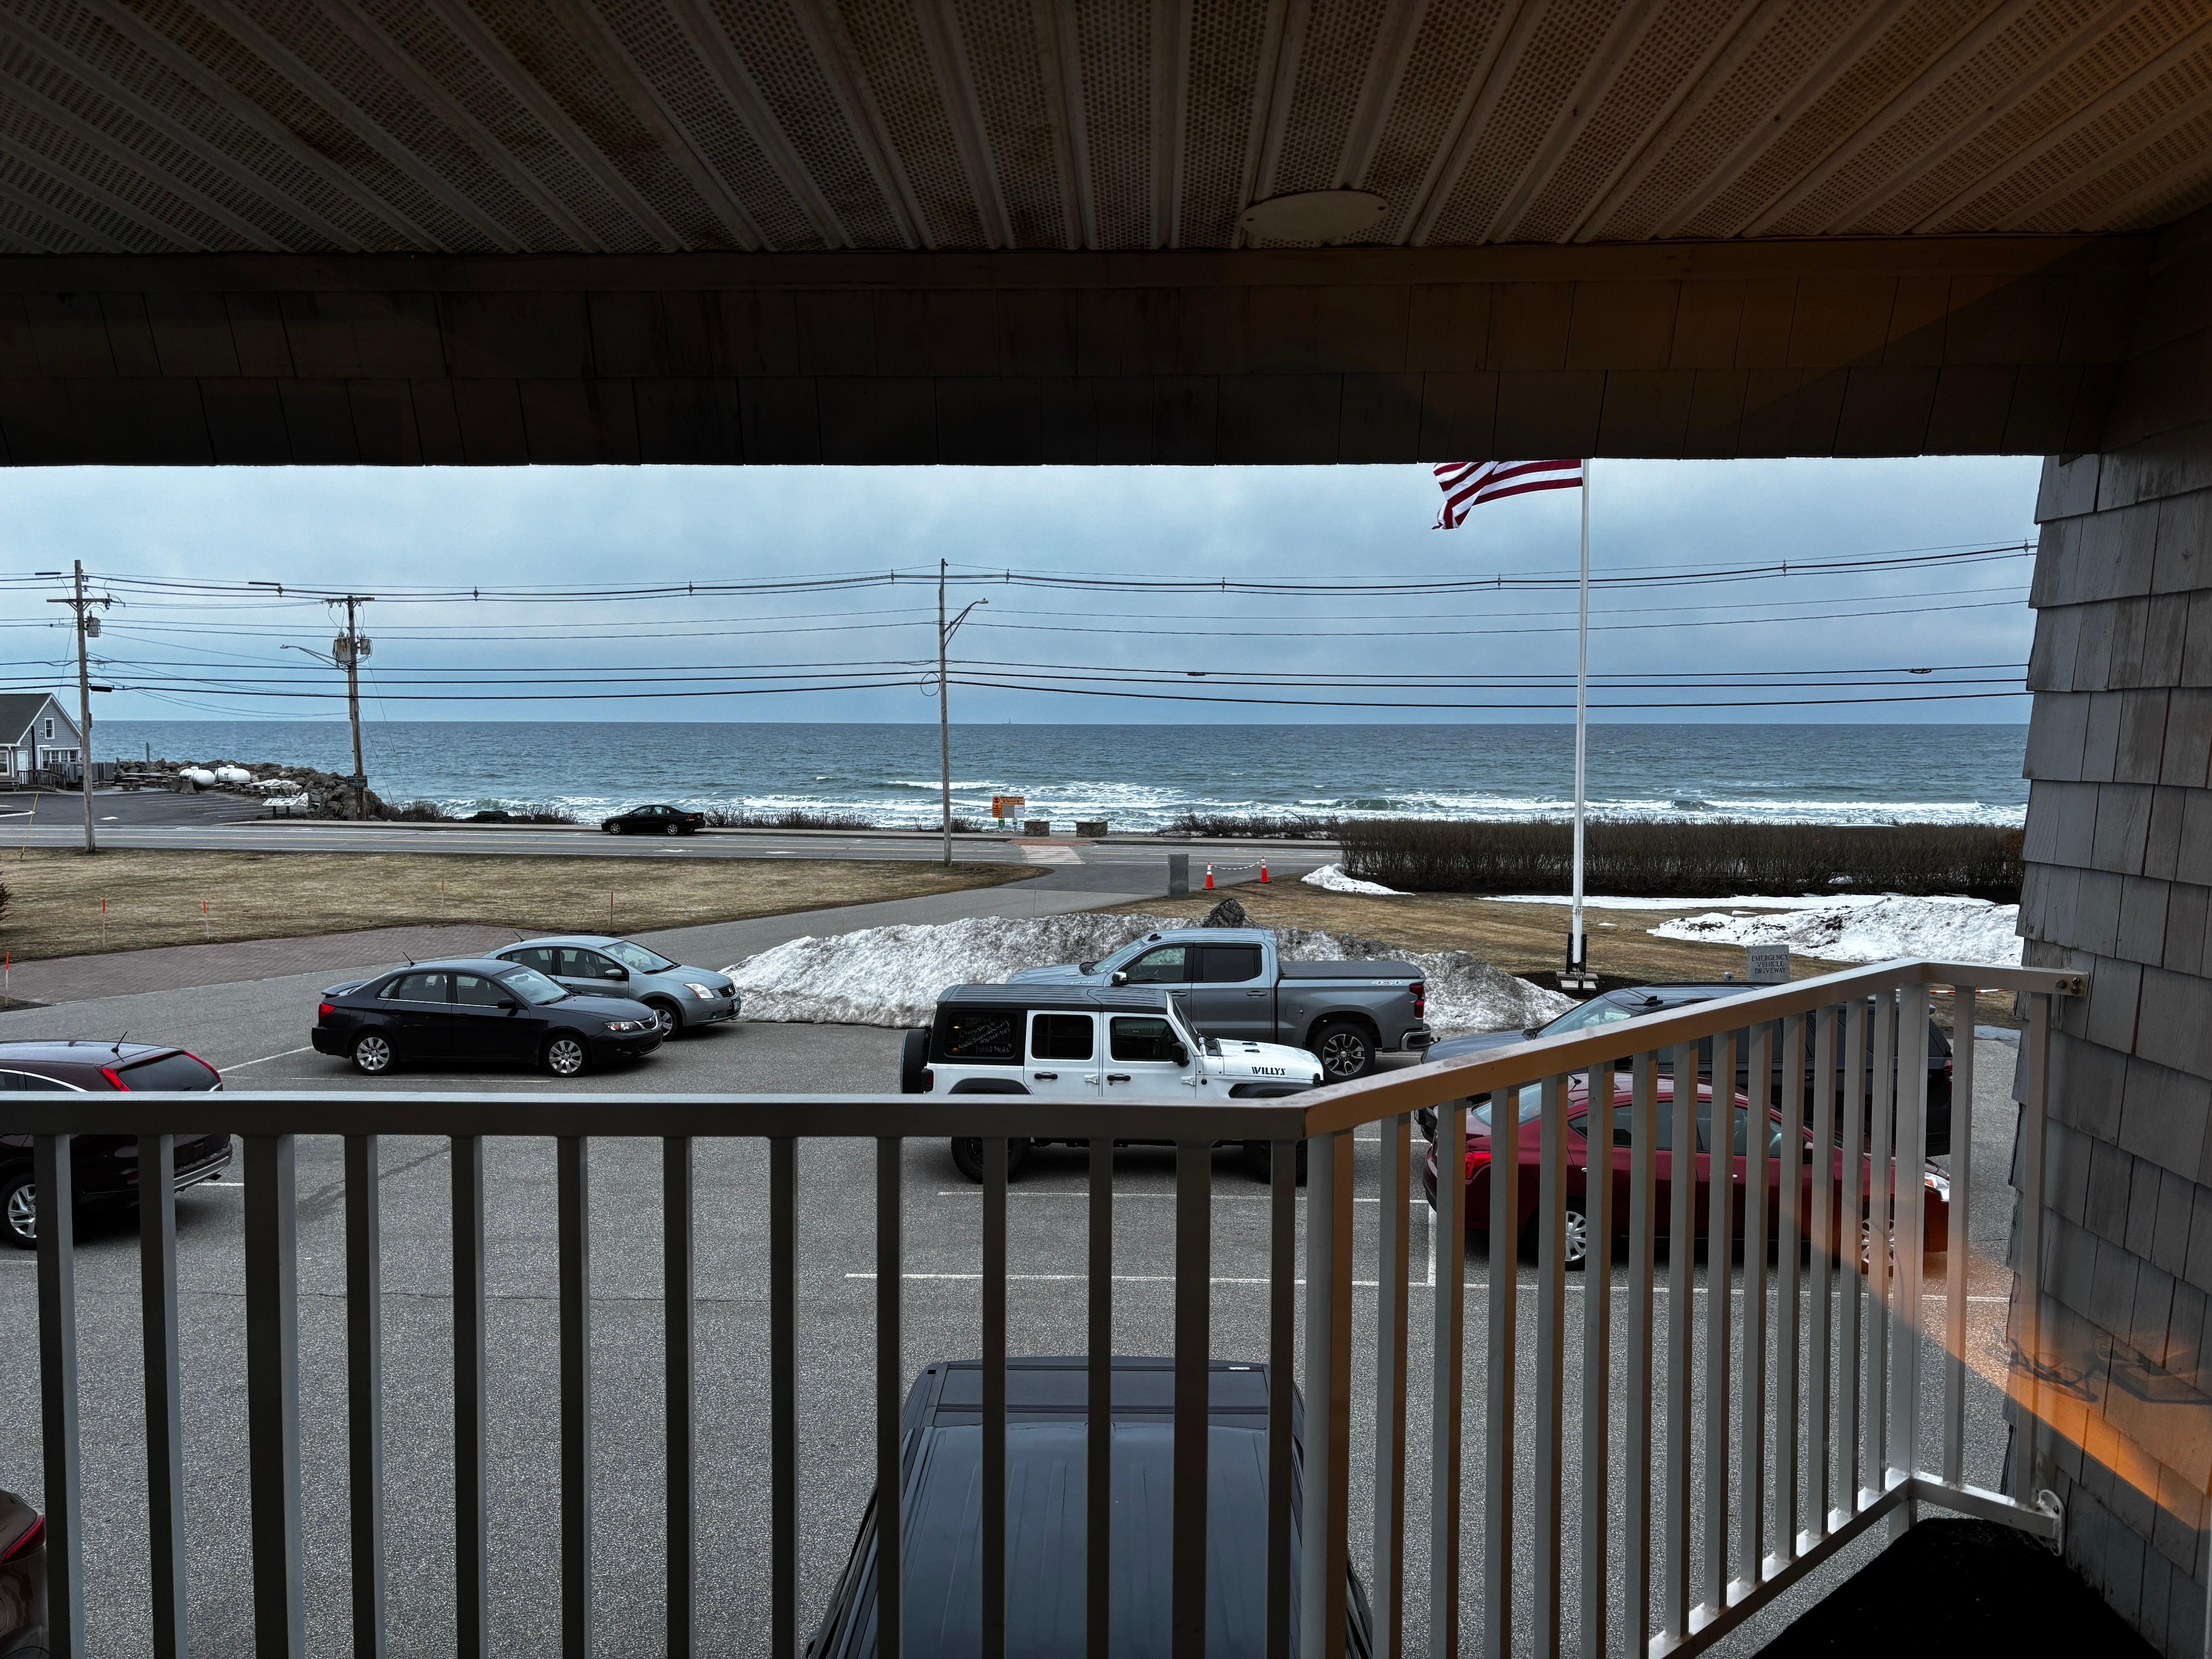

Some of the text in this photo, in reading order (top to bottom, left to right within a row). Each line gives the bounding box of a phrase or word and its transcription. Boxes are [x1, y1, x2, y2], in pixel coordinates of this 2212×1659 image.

[976, 1044, 1012, 1055] Need Meds?
[1252, 1066, 1286, 1075] WILLYS
